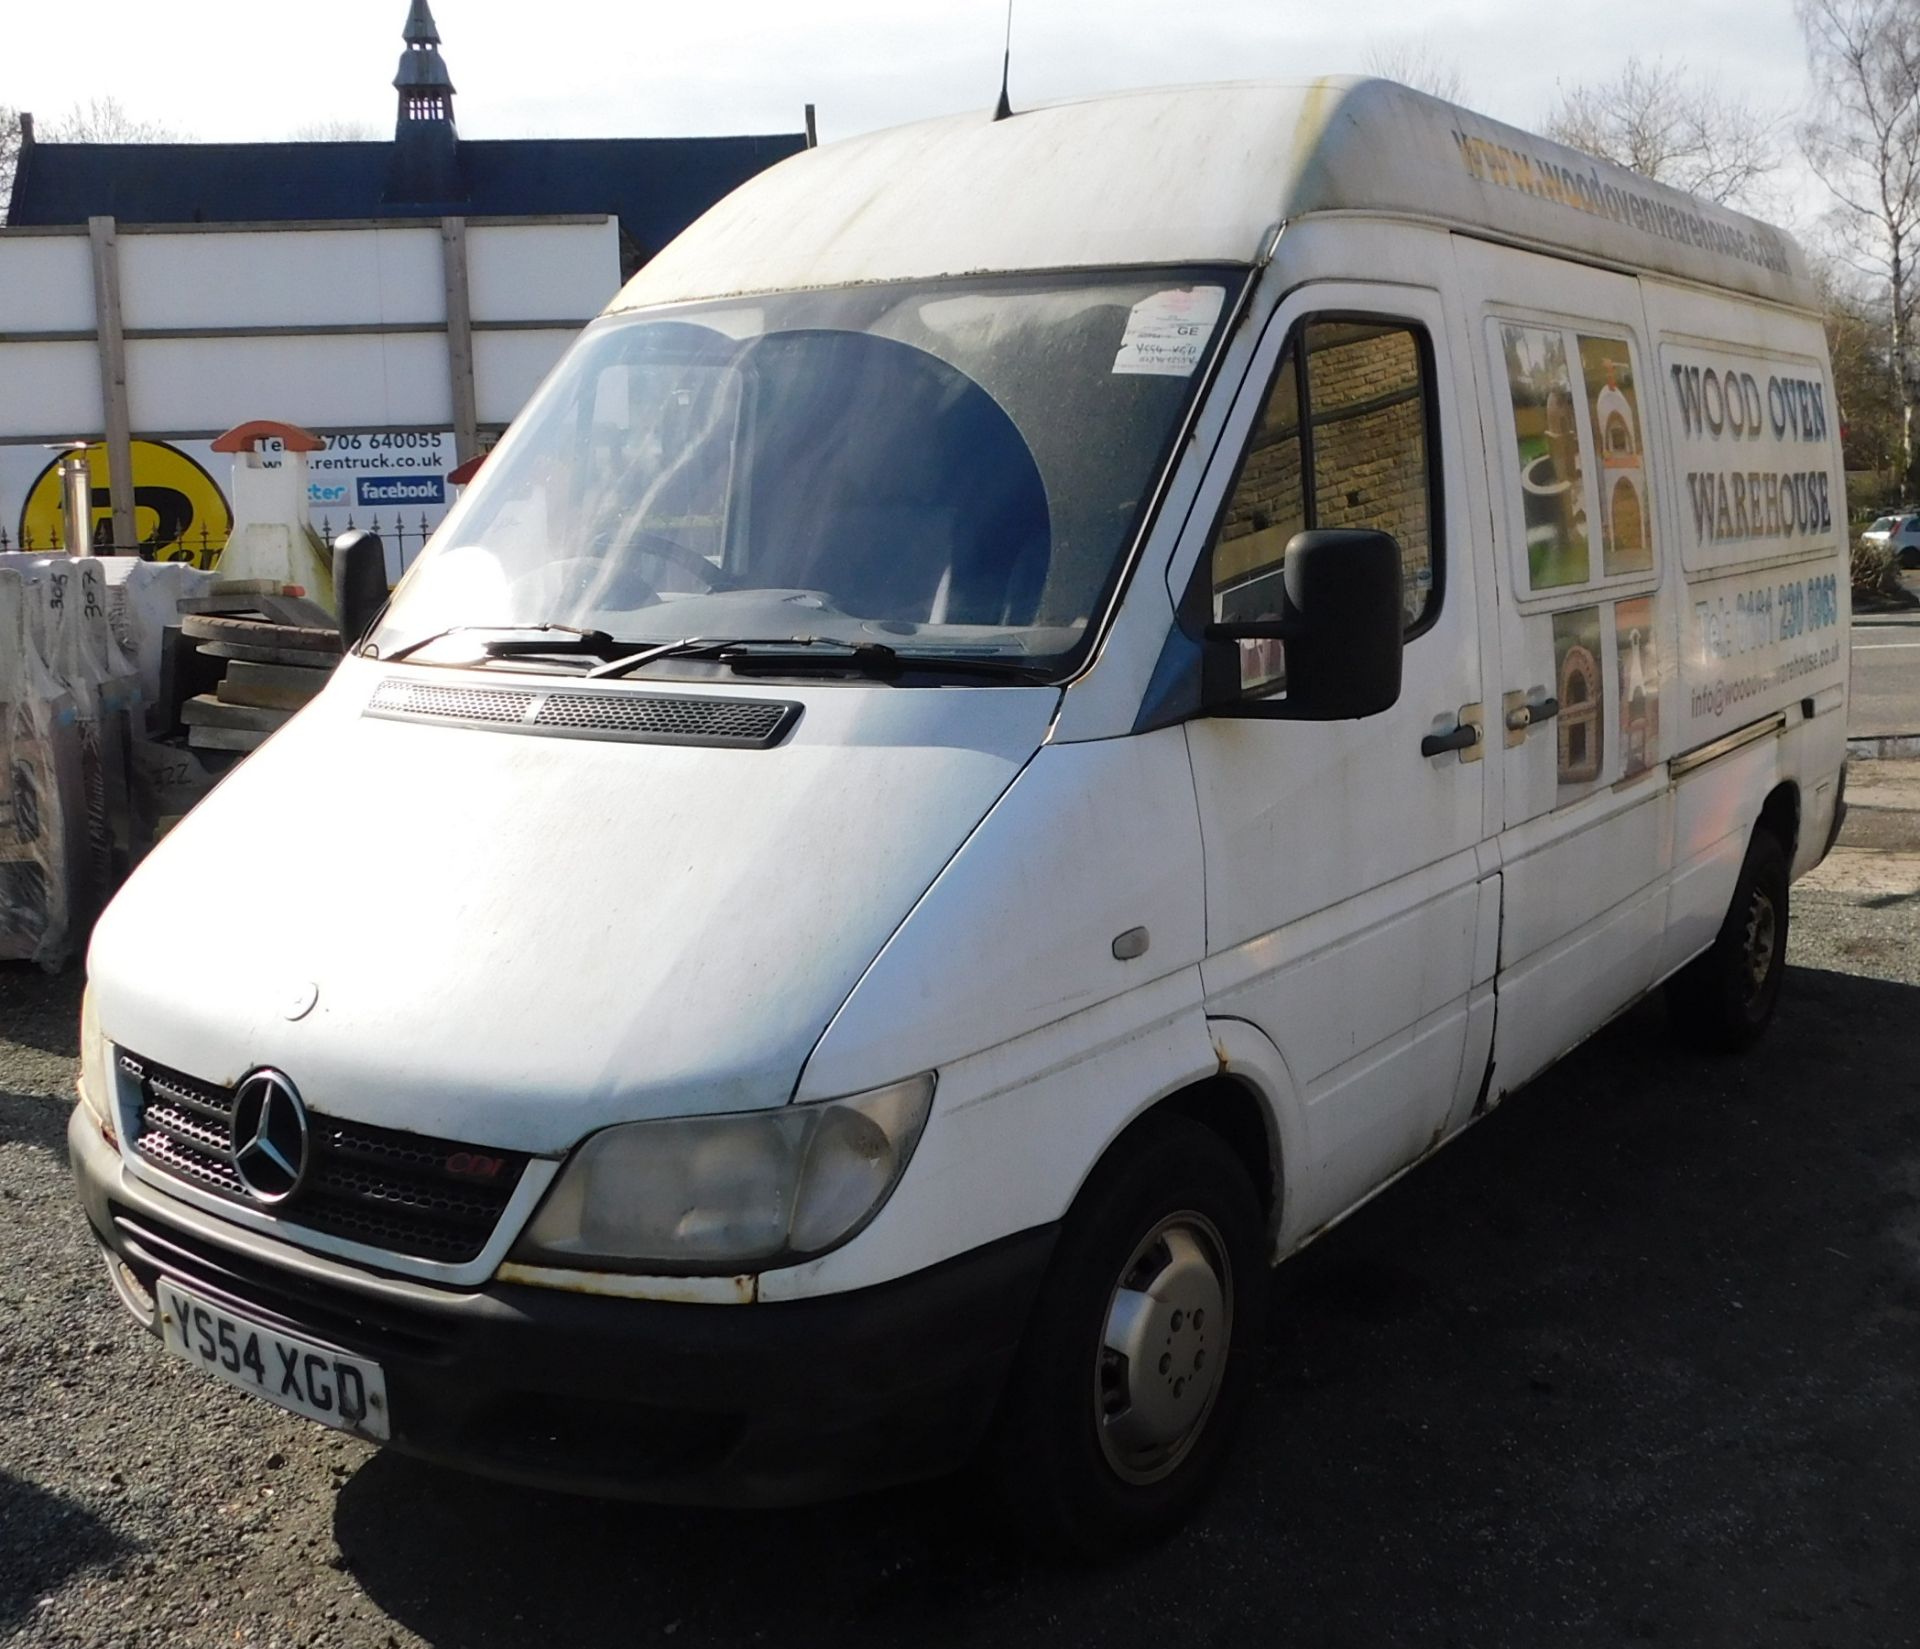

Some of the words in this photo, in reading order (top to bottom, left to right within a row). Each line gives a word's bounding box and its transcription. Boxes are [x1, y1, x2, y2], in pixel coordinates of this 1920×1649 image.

[1177, 326, 1200, 336] GE
[1670, 364, 1762, 440] WOOD
[1768, 375, 1827, 441] OVEN
[370, 433, 441, 449] 640055
[361, 481, 439, 500] facebook
[1687, 471, 1831, 547] WAREHOUSE
[81, 569, 103, 621] 307
[171, 1294, 265, 1385] YS54
[275, 1341, 367, 1422] XGD
